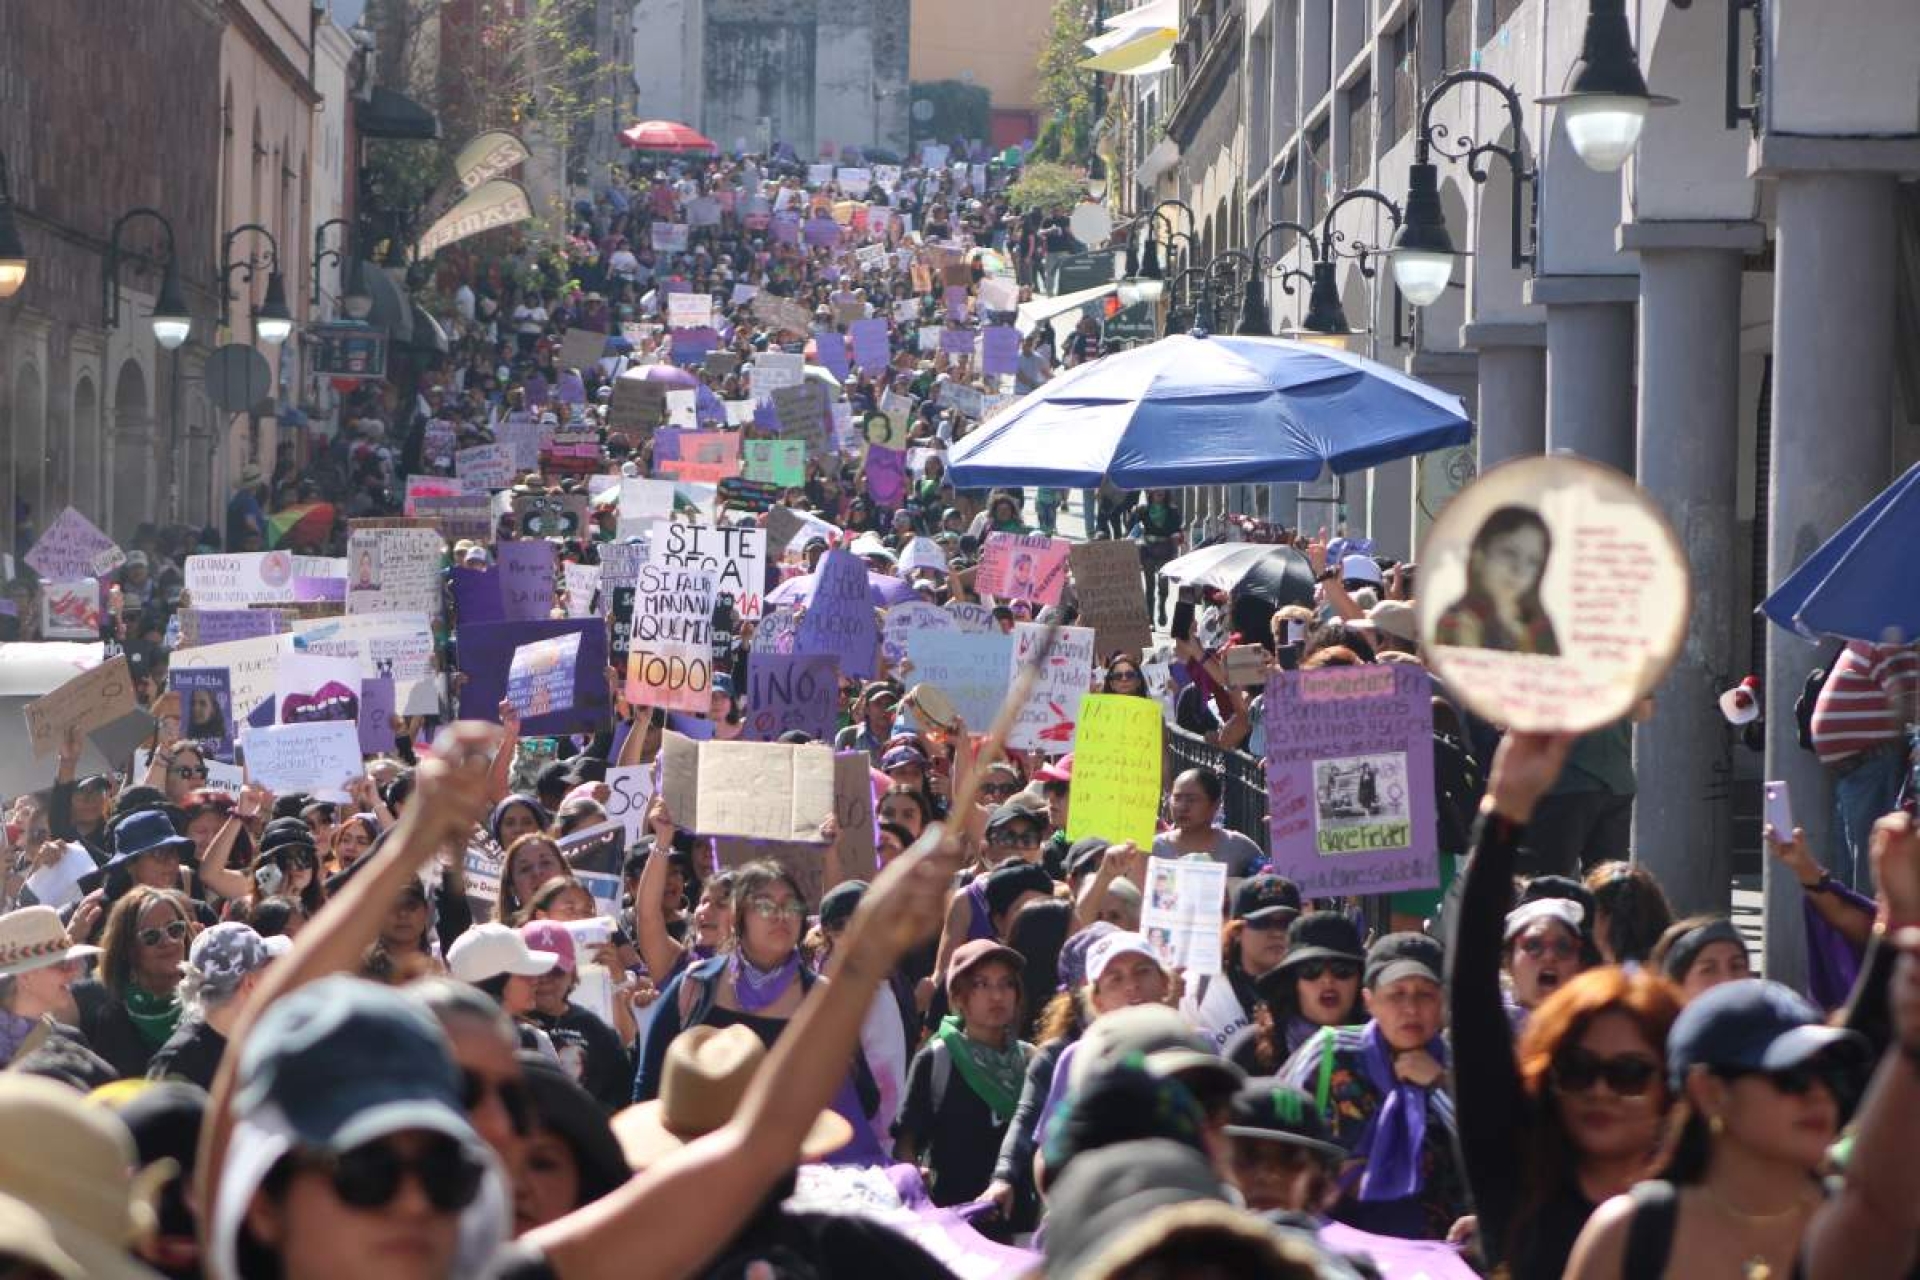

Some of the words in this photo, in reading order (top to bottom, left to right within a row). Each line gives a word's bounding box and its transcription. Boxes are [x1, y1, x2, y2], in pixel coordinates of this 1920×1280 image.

[667, 524, 707, 555] SI
[717, 527, 756, 559] TE
[641, 565, 671, 593] SI
